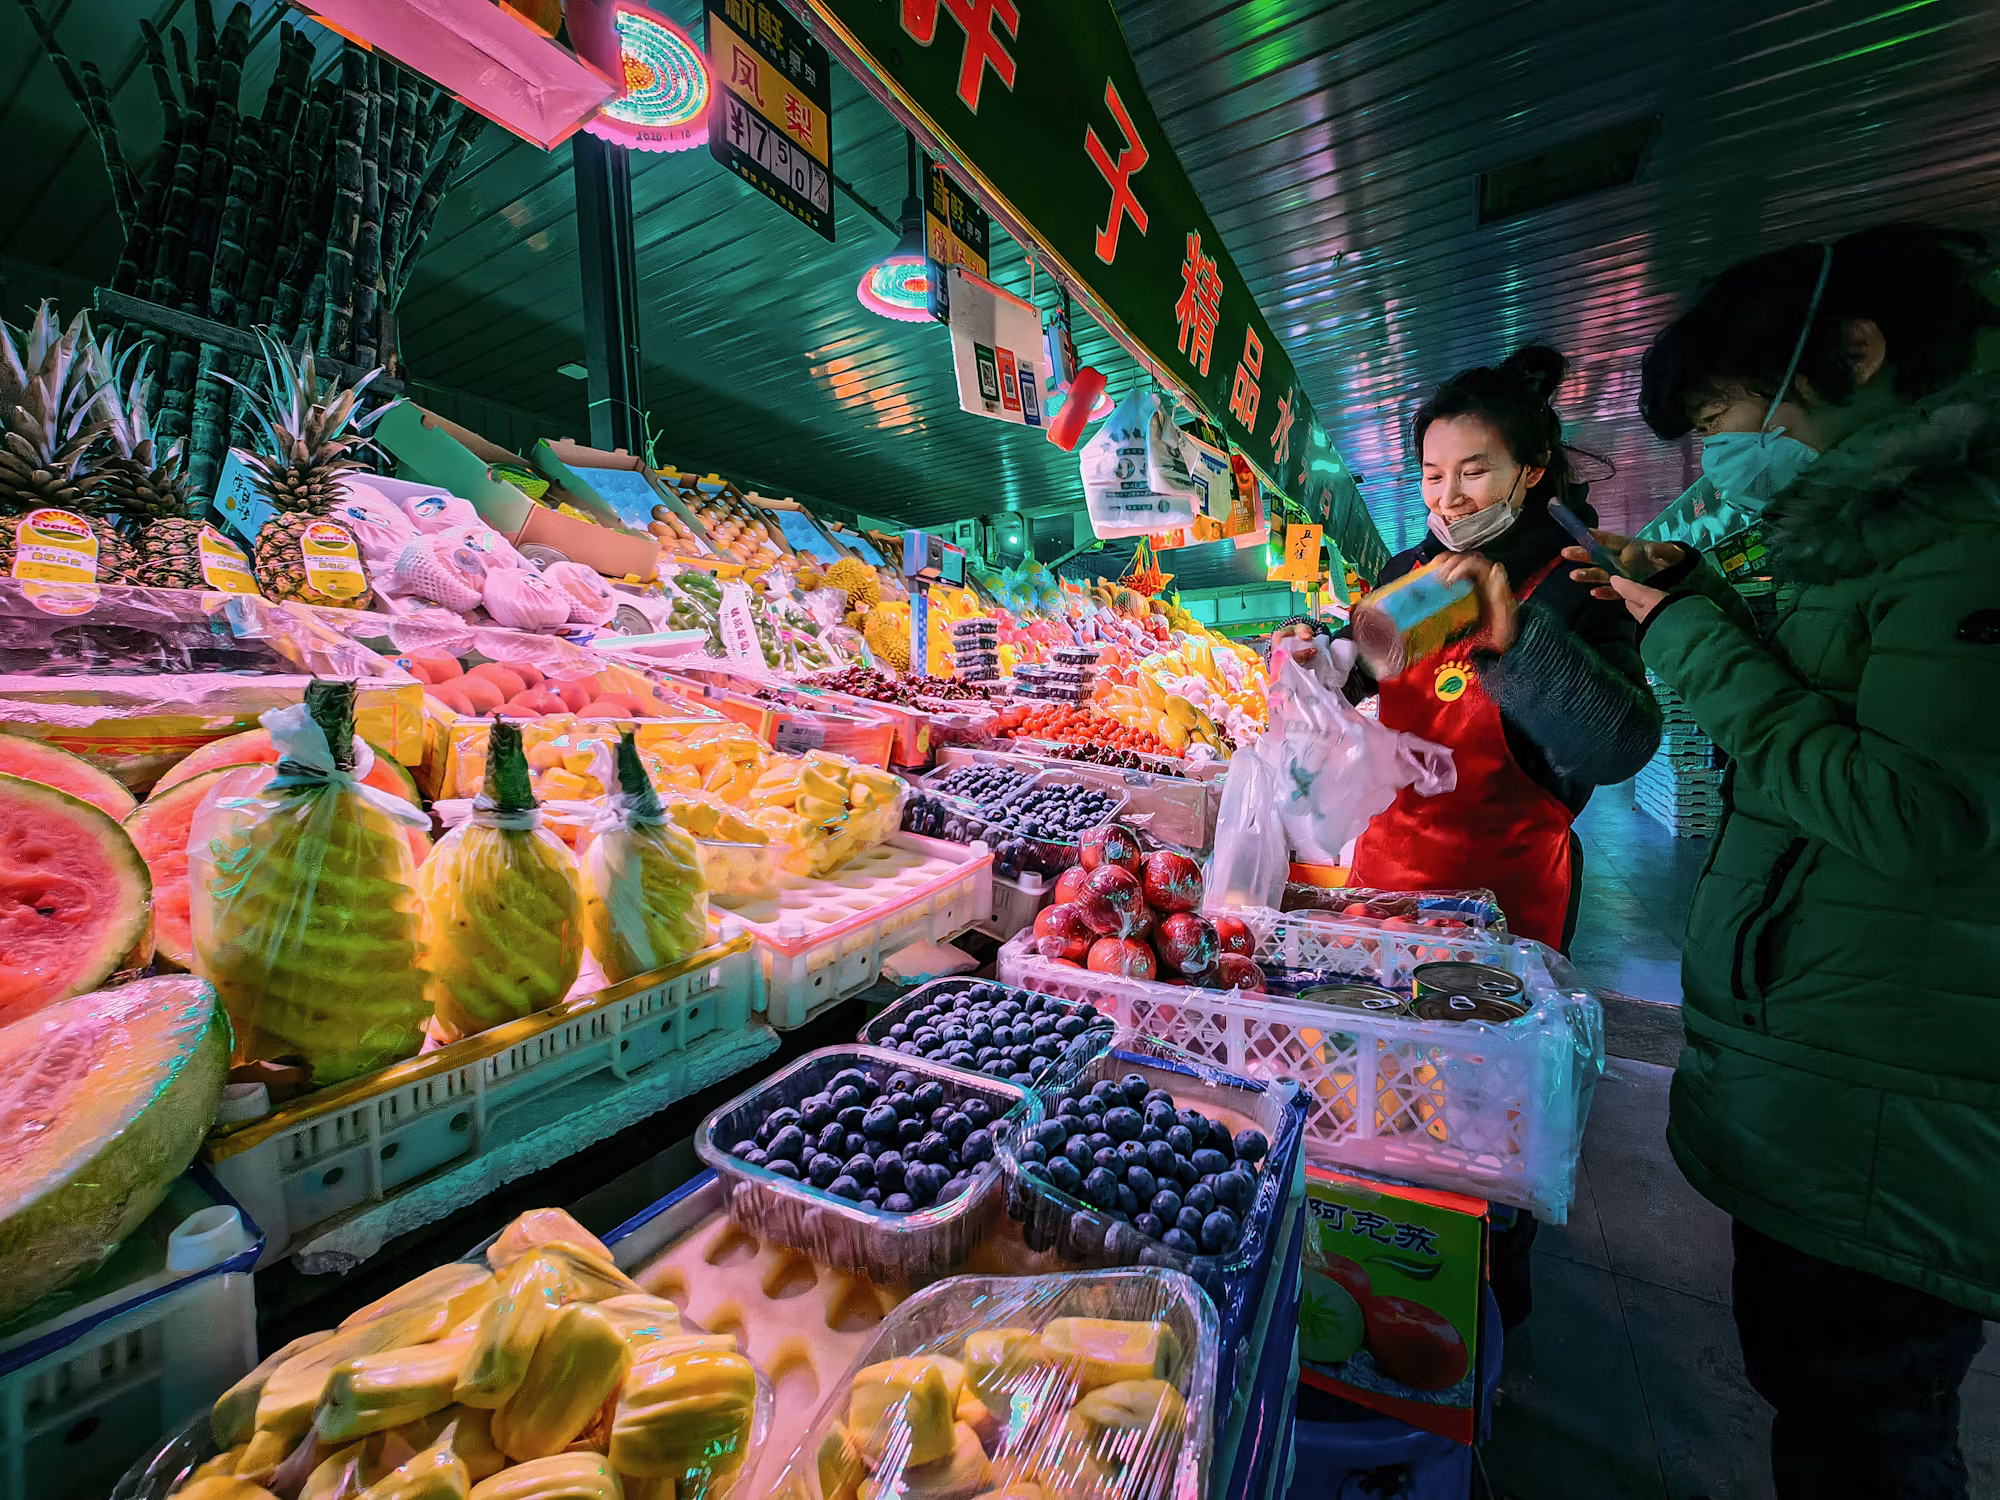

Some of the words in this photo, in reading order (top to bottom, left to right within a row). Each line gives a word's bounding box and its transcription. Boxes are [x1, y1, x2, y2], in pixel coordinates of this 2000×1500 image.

[731, 43, 814, 149] 凤梨
[31, 520, 90, 537] Everich
[310, 533, 350, 543] Everich
[1308, 1198, 1439, 1256] 阿克苏
